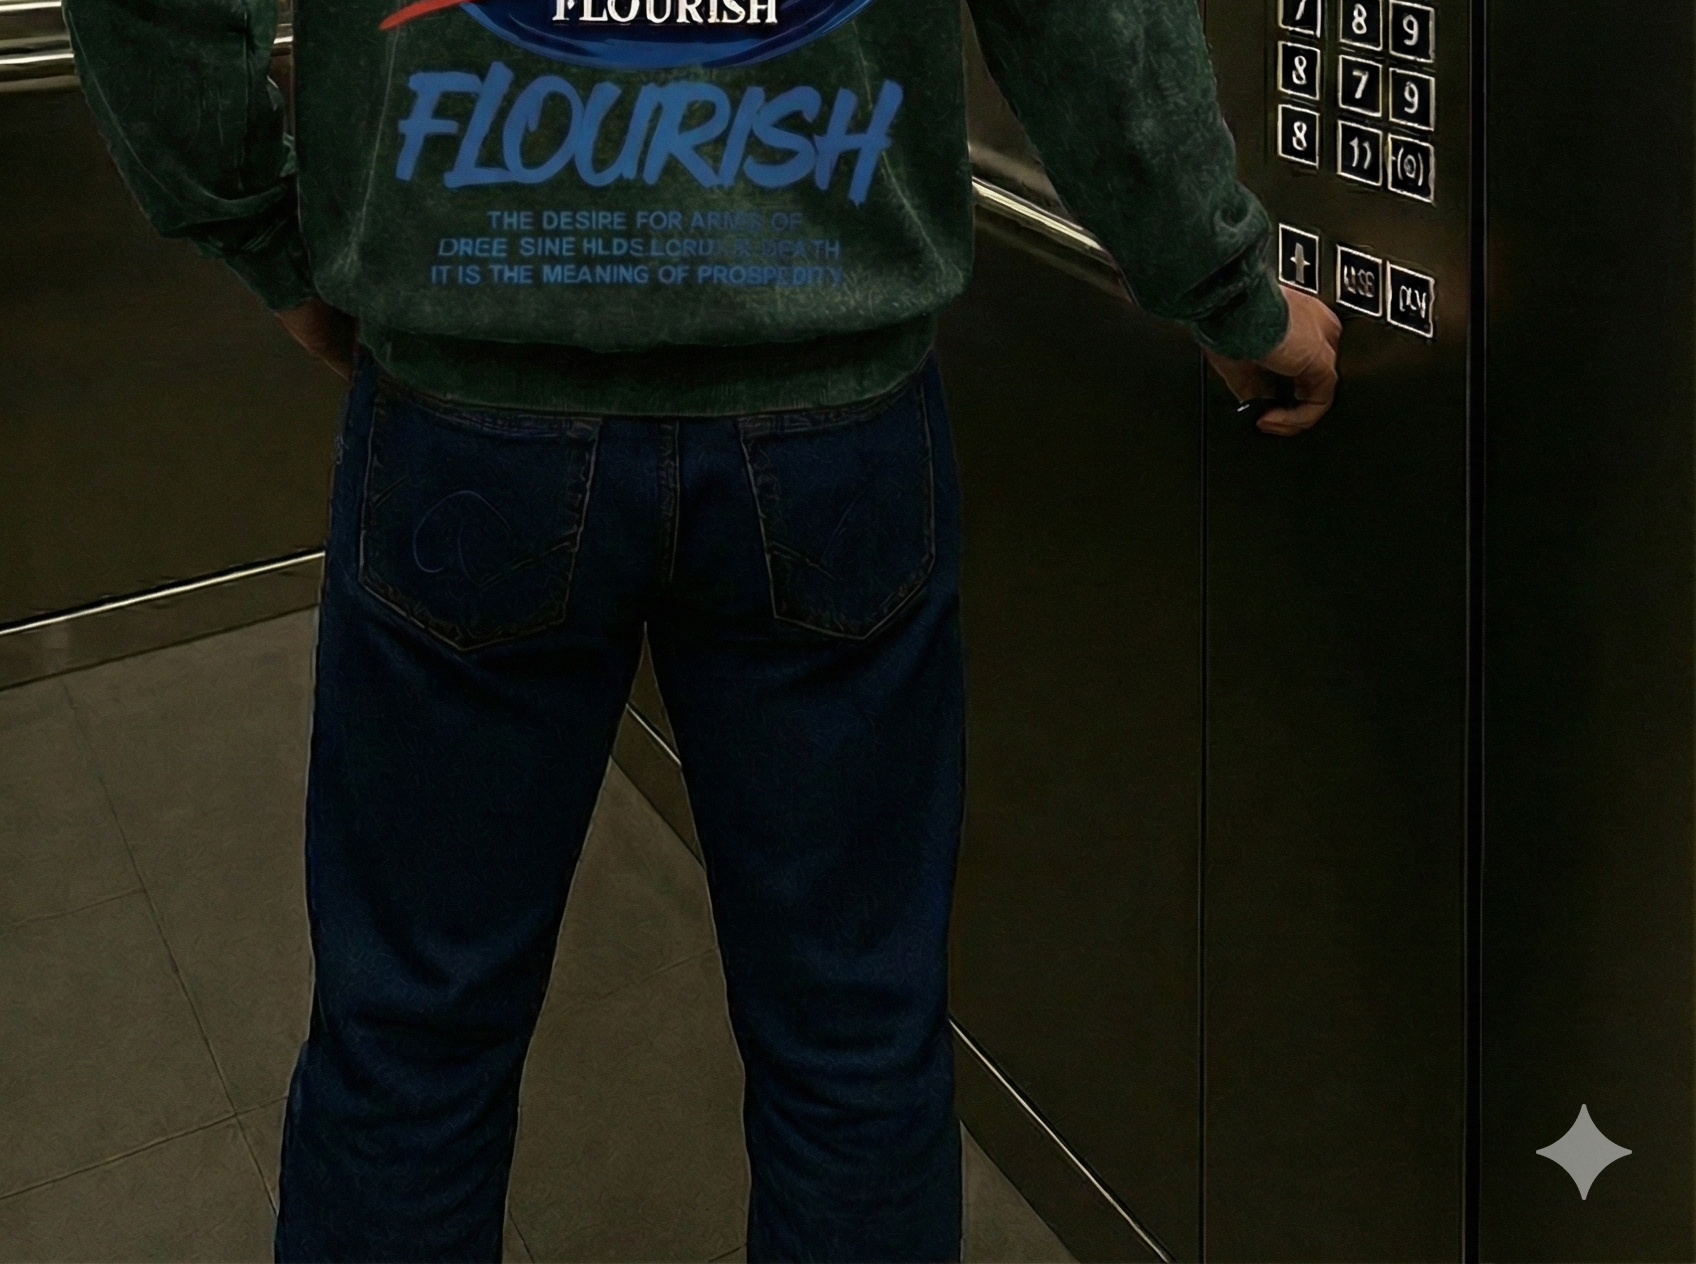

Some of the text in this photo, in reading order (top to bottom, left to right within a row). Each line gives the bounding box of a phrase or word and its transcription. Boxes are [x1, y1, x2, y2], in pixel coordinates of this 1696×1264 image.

[1351, 3, 1367, 35] 8
[1402, 14, 1419, 46] 9
[1404, 81, 1419, 114] 9
[395, 61, 904, 207] FLOURISH
[486, 210, 534, 231] THE
[542, 210, 628, 231] DESIRE
[635, 210, 683, 231] FOR
[518, 237, 576, 258] SINE
[430, 264, 452, 285] IT
[457, 264, 482, 285] IS
[488, 264, 534, 285] THE
[541, 264, 650, 285] MEANING
[656, 264, 690, 285] OF
